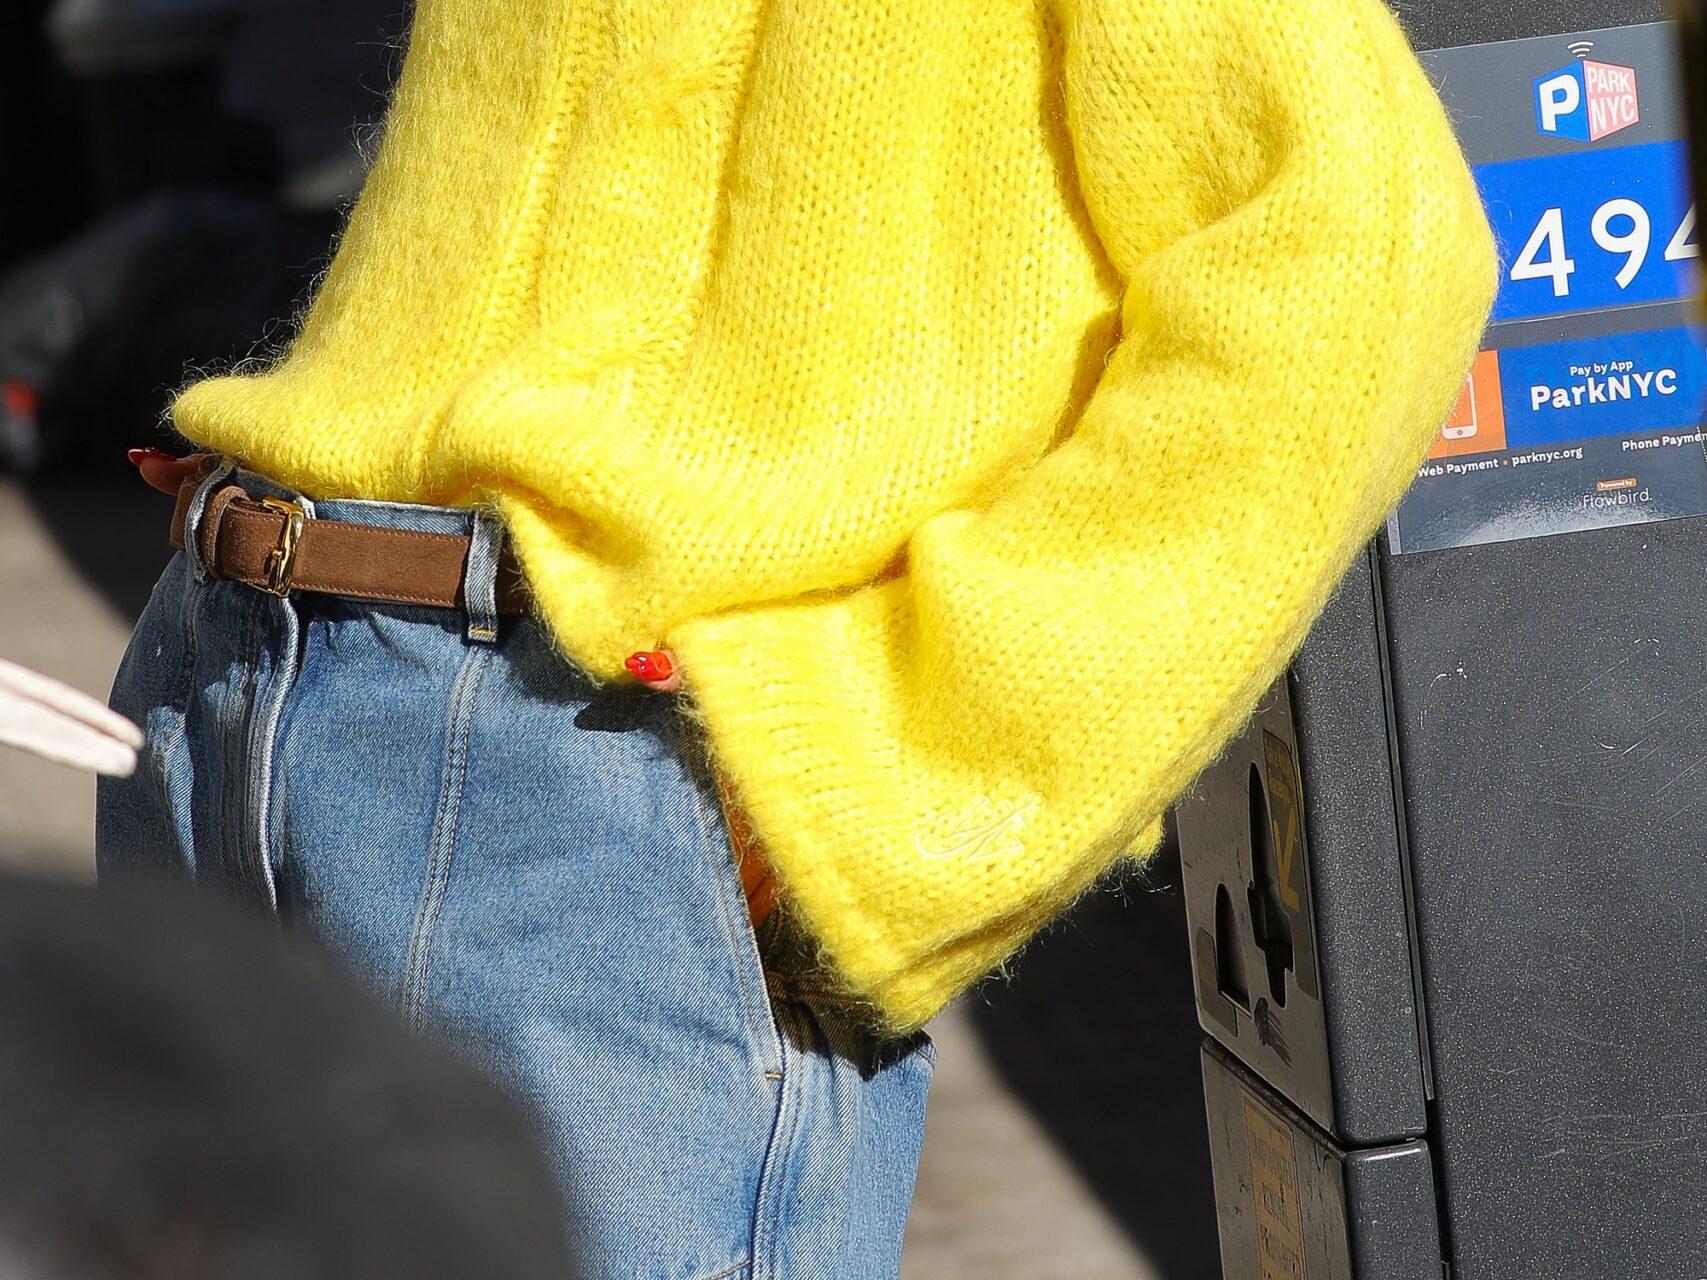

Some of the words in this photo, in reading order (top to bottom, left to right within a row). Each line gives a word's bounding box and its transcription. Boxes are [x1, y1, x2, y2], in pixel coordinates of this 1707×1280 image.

[1586, 66, 1632, 94] PARK
[1539, 74, 1580, 131] P
[1589, 94, 1636, 134] NYC
[1570, 365, 1592, 377] Pay
[1593, 363, 1608, 375] by
[1610, 360, 1634, 372] App
[1530, 369, 1677, 411] ParkNYC
[1622, 437, 1660, 451] Phone
[1418, 463, 1443, 478] Web
[1446, 458, 1499, 476] Payment
[1511, 447, 1583, 466] parknyc.org
